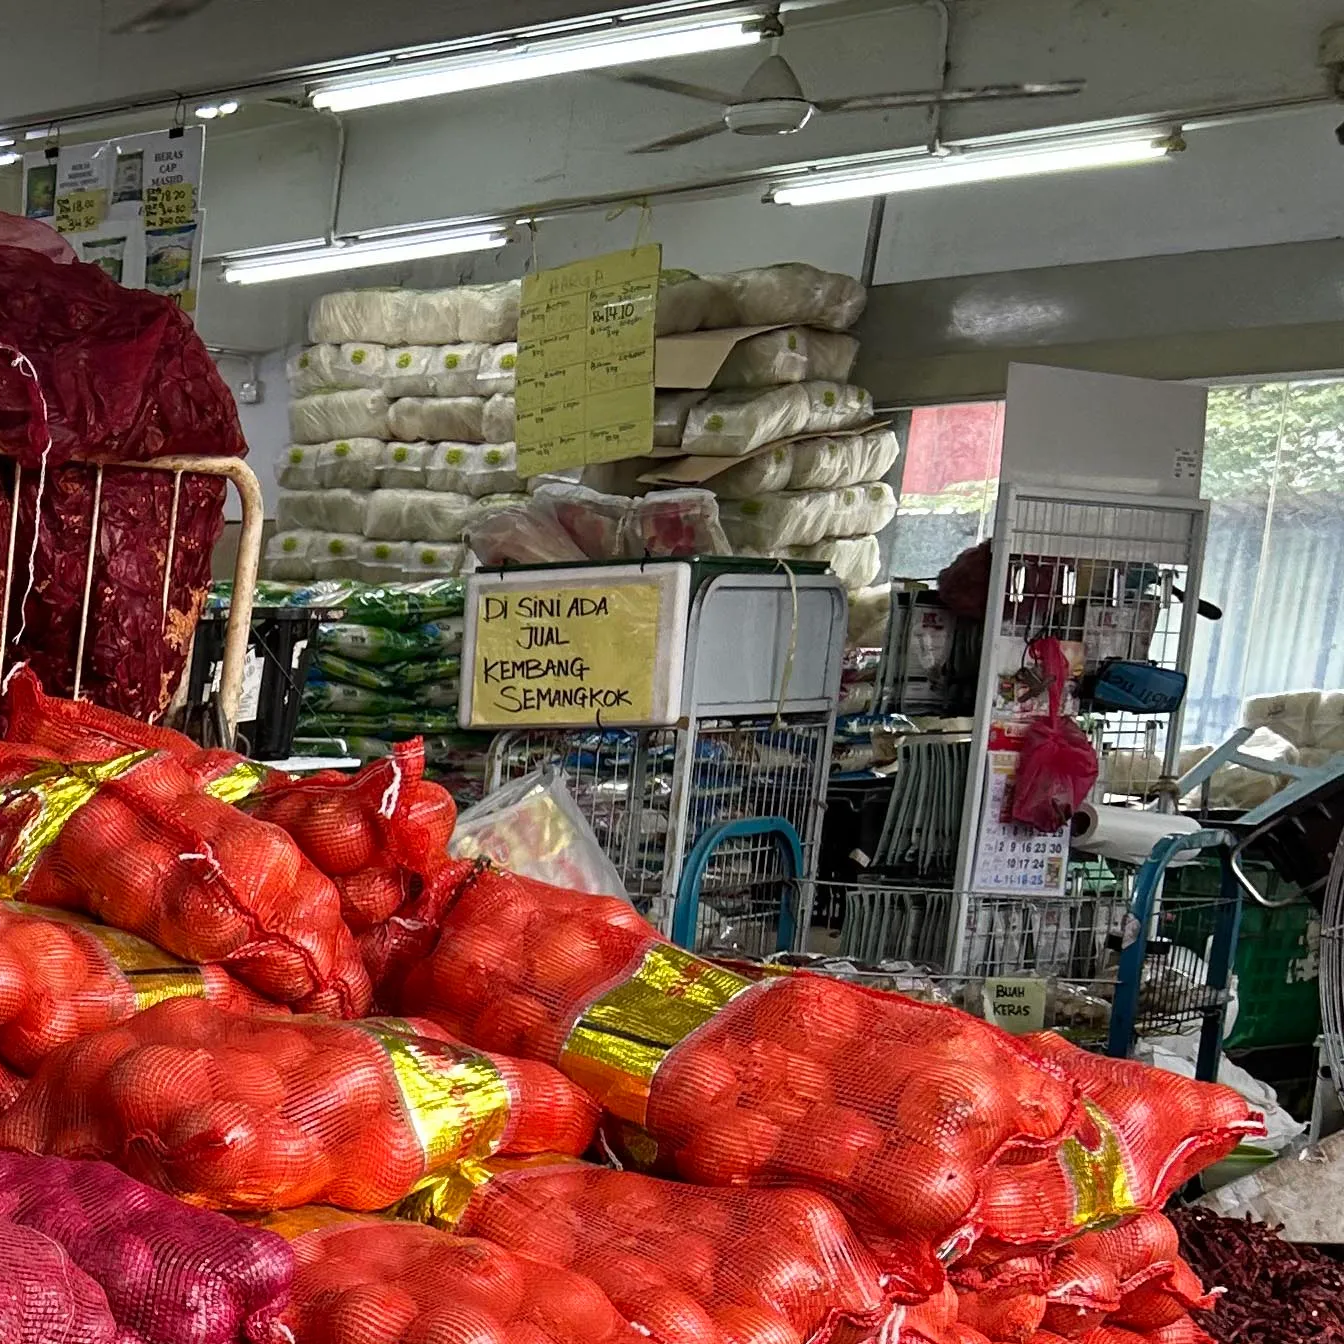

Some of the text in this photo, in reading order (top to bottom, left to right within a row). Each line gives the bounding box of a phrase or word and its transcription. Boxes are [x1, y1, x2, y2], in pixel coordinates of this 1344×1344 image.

[567, 596, 609, 618] ADA
[516, 622, 570, 649] JUAL
[483, 656, 590, 683] KEMBANG
[493, 686, 632, 713] SEMANGKOK
[996, 984, 1025, 998] BUAH
[992, 1001, 1031, 1016] KERAS
